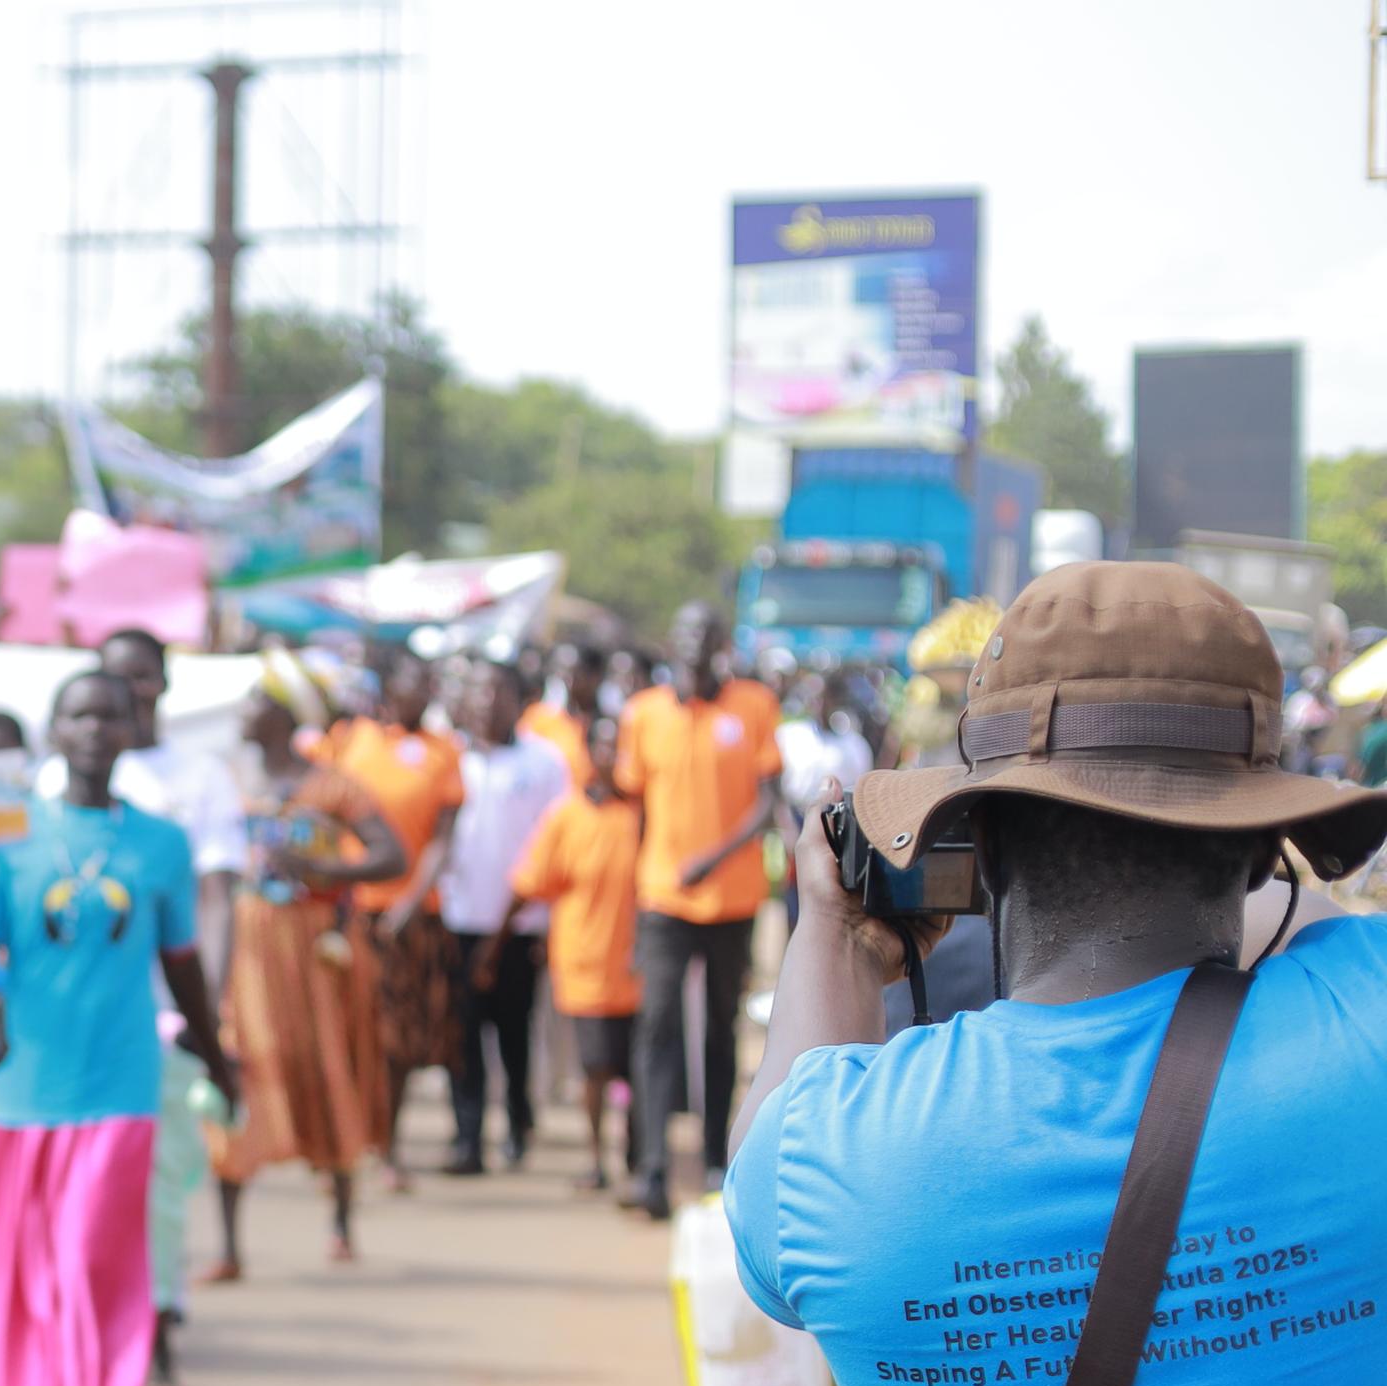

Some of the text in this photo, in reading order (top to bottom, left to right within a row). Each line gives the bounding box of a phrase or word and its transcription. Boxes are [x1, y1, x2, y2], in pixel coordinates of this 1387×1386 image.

[903, 1243, 1319, 1322] End Obstetri tula 2025:
[954, 1249, 1104, 1283] Internatio
[1226, 1225, 1256, 1246] to
[944, 1287, 1288, 1352] Her Healt er Right:
[995, 1360, 1017, 1382] A
[1025, 1354, 1076, 1380] Fut
[1139, 1326, 1262, 1364] Without
[1270, 1299, 1377, 1342] Fistula
